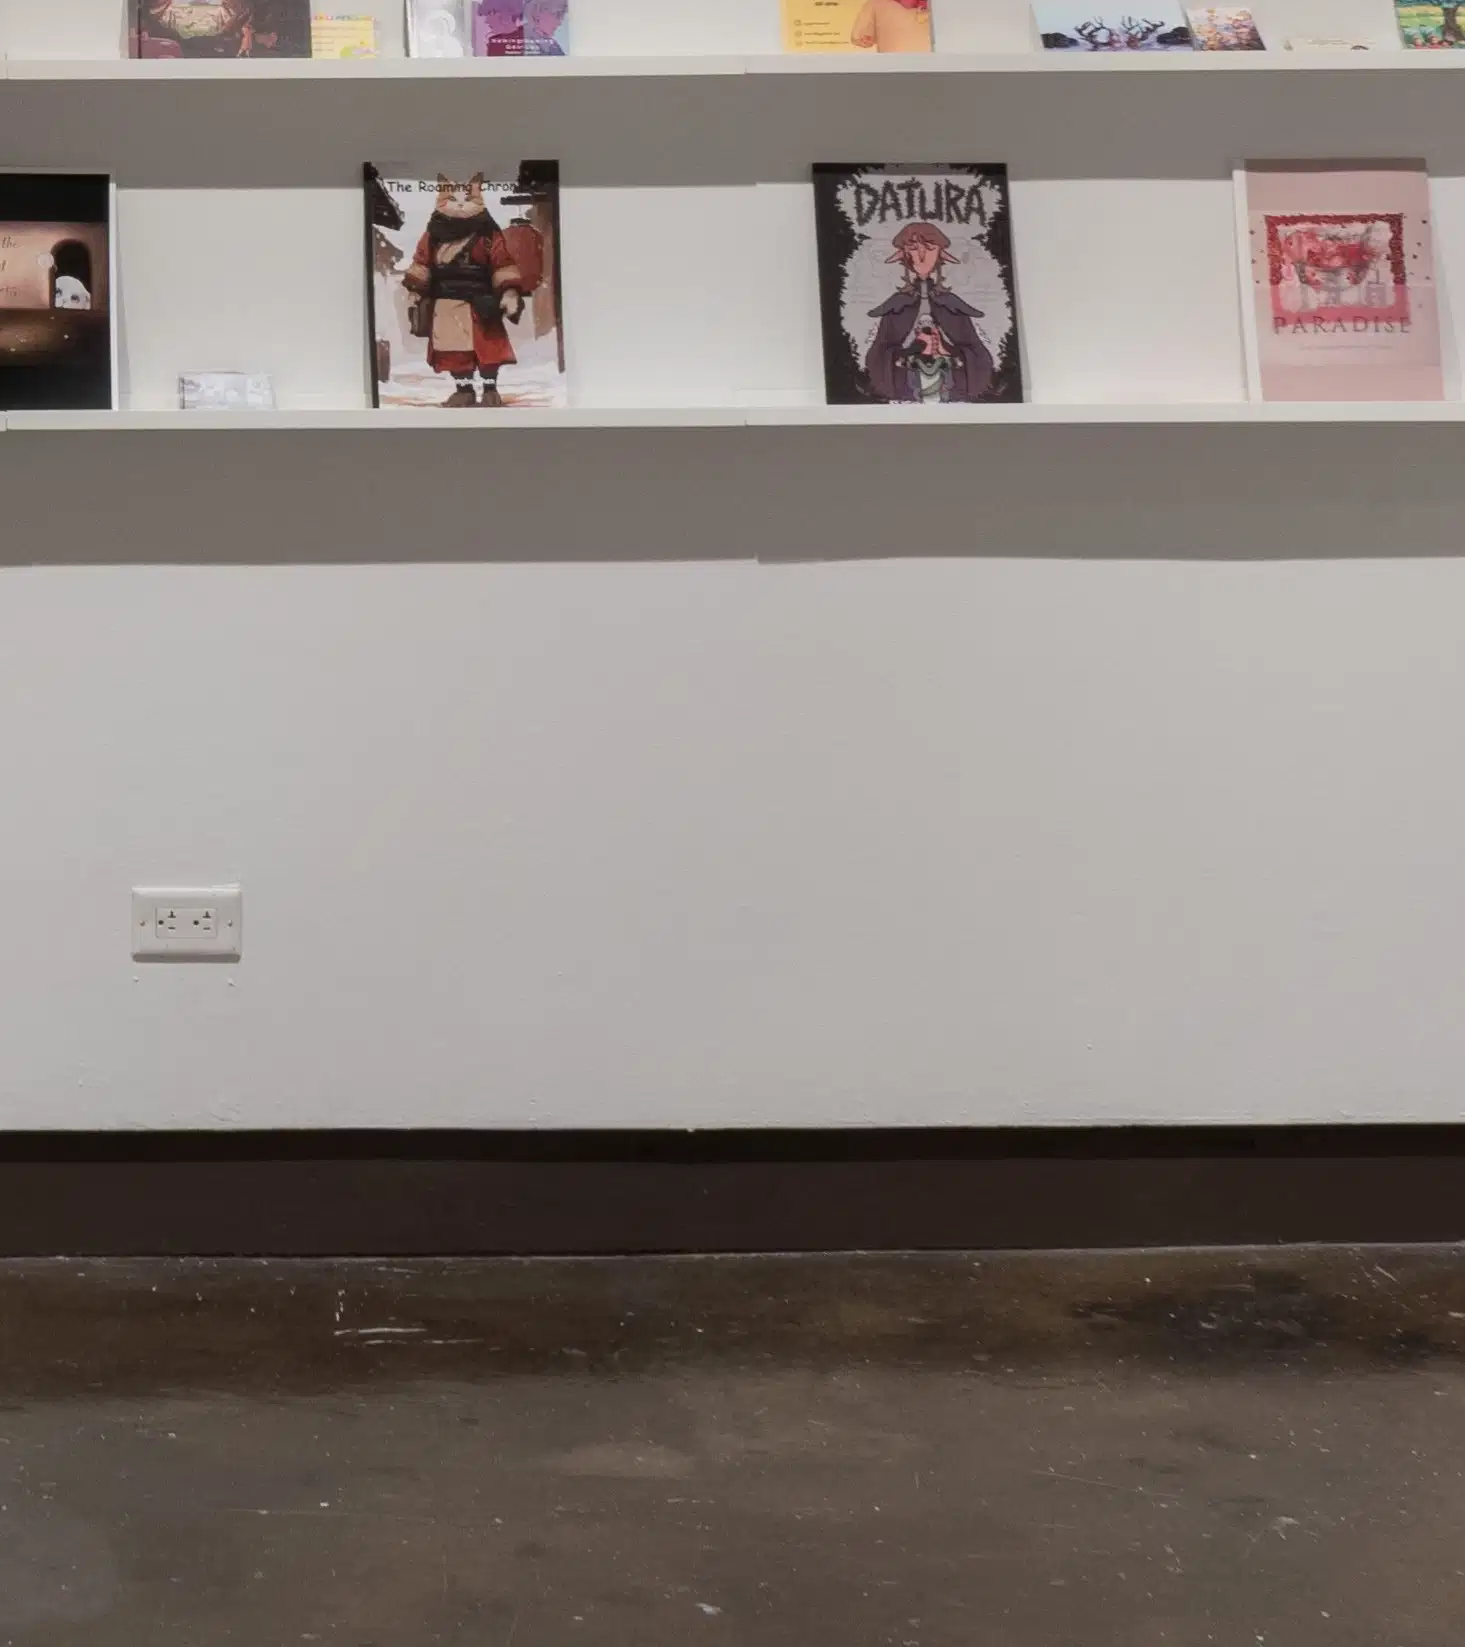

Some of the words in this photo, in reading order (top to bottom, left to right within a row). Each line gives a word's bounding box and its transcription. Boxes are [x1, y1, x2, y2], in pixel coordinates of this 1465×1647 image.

[387, 181, 413, 193] The
[419, 181, 473, 196] Roaming
[854, 177, 989, 226] DATURA
[1272, 316, 1412, 335] PARADISE
